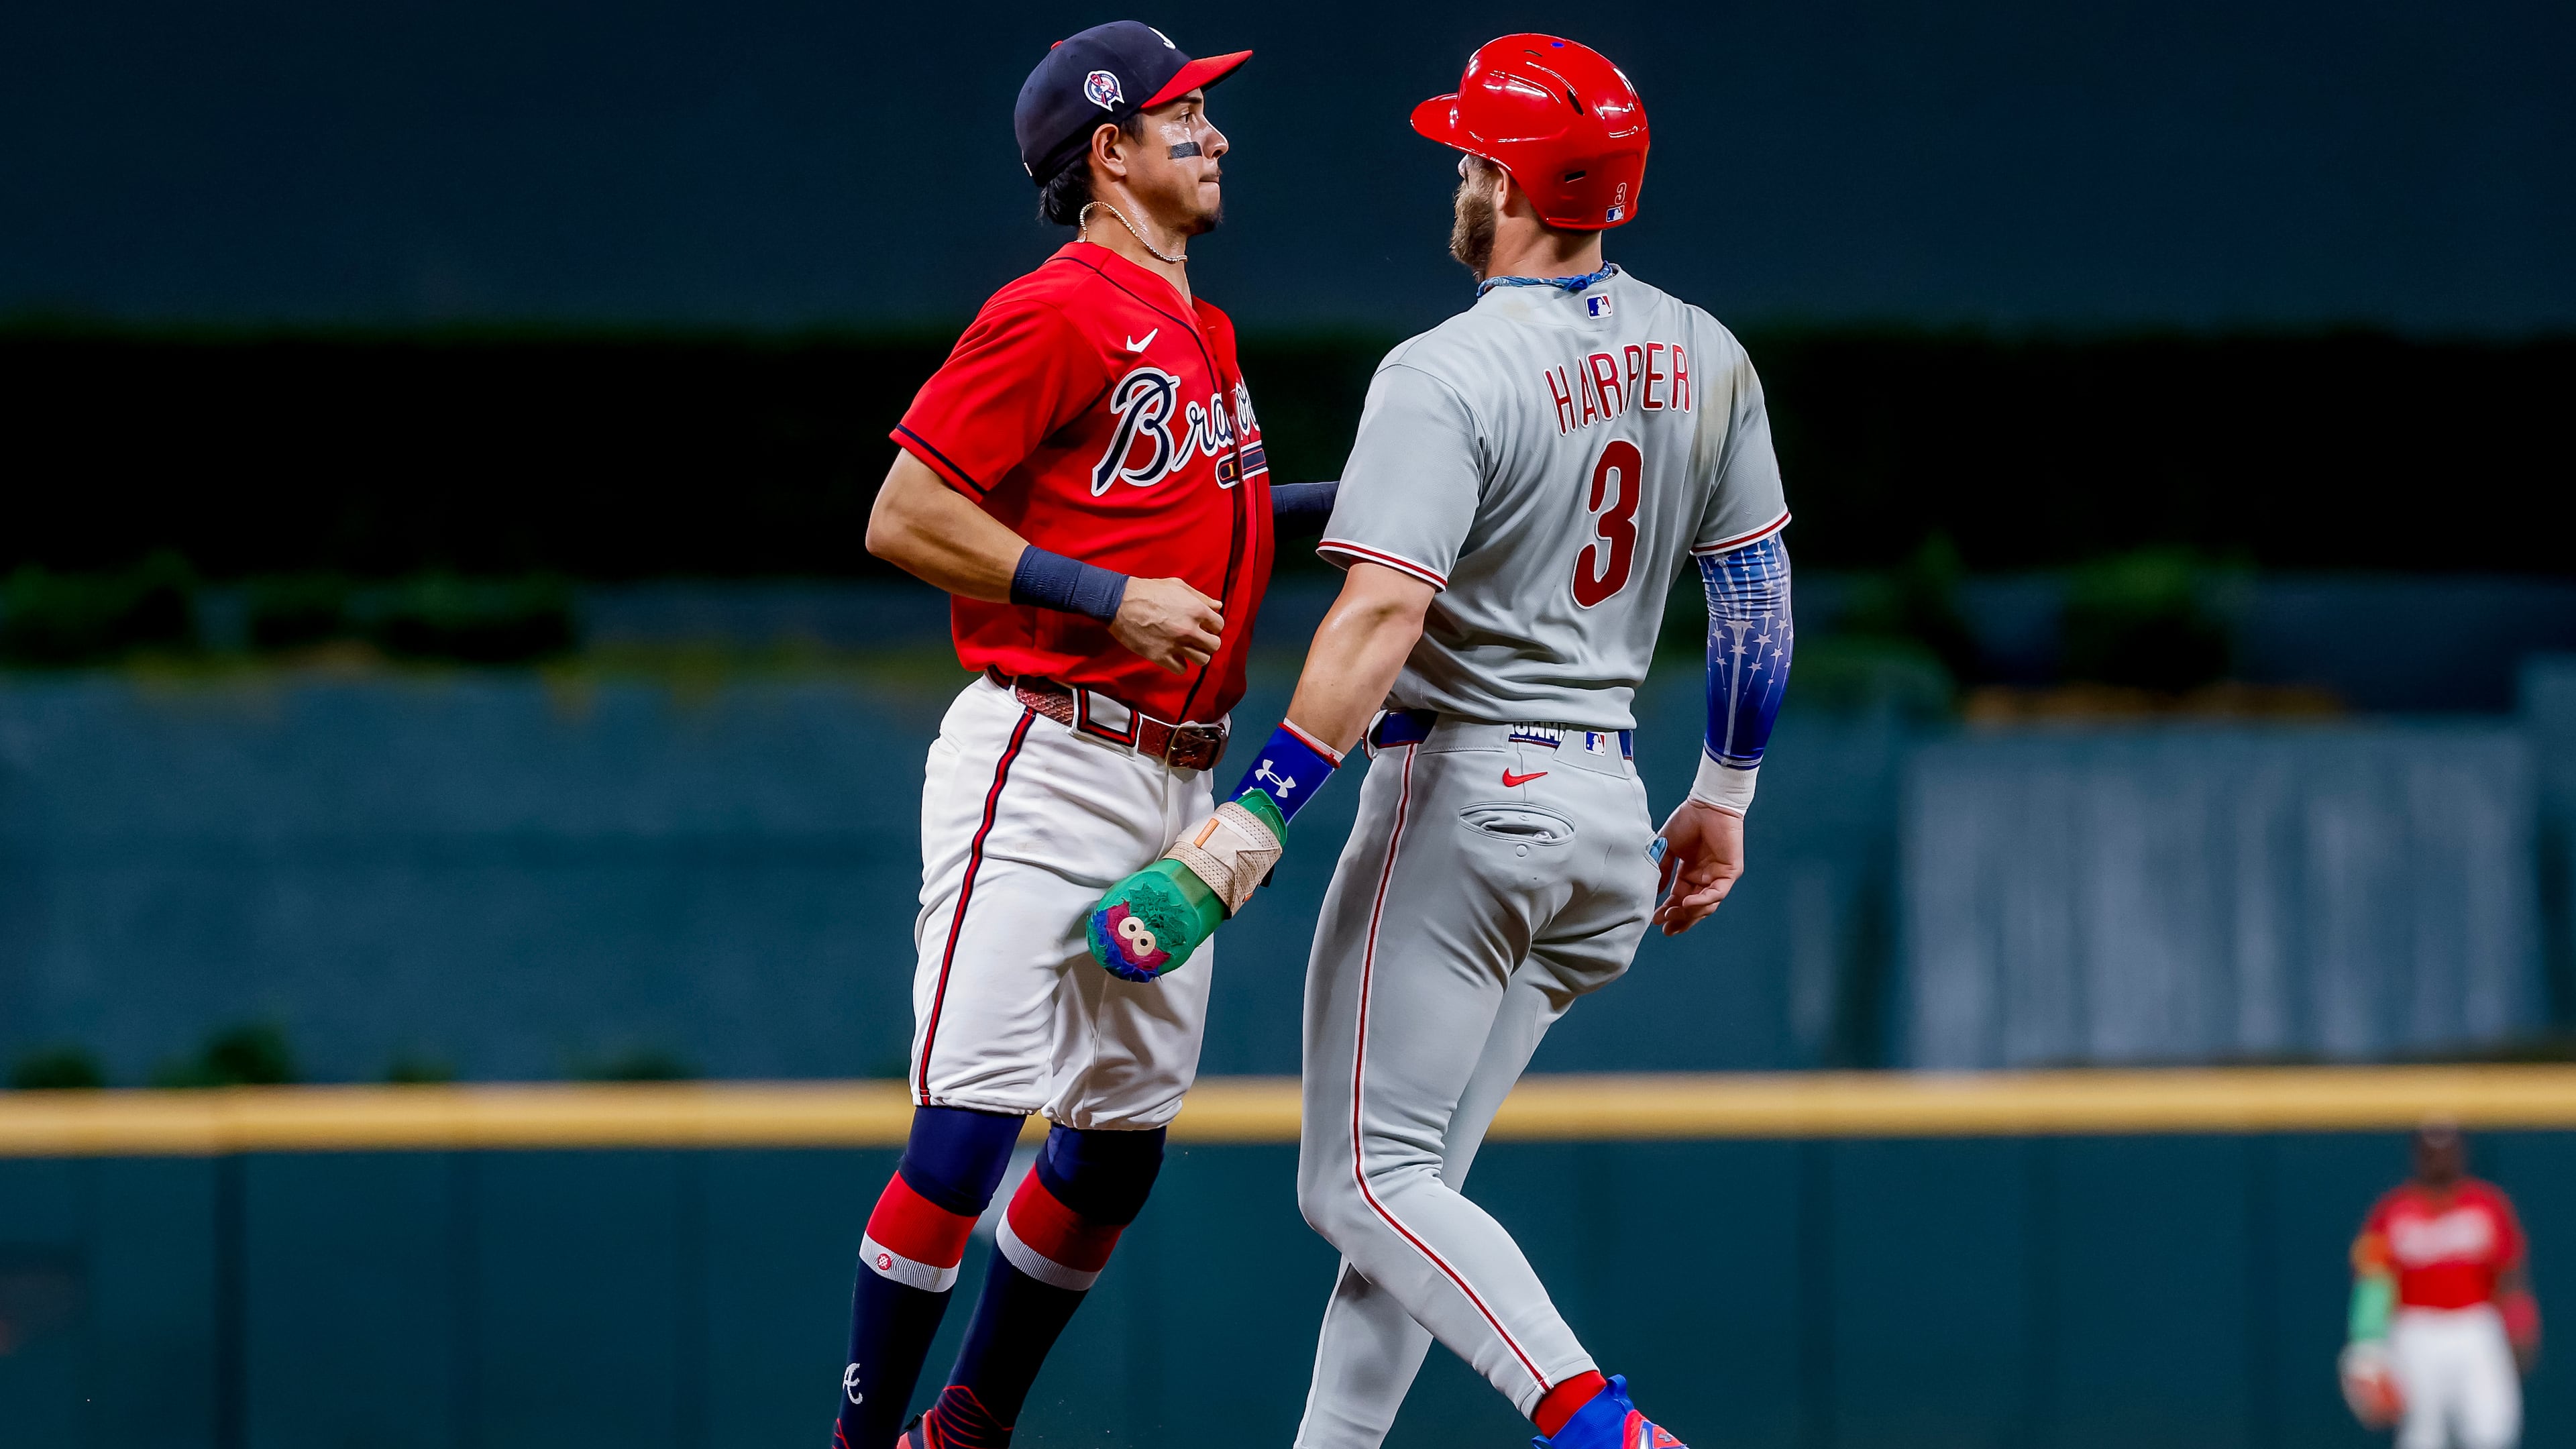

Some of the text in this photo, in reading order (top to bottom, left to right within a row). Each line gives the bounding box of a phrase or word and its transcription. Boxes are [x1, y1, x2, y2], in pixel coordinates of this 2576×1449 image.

[1615, 182, 1627, 205] 3
[1543, 341, 1692, 437] HARPER
[1570, 438, 1644, 611] 3
